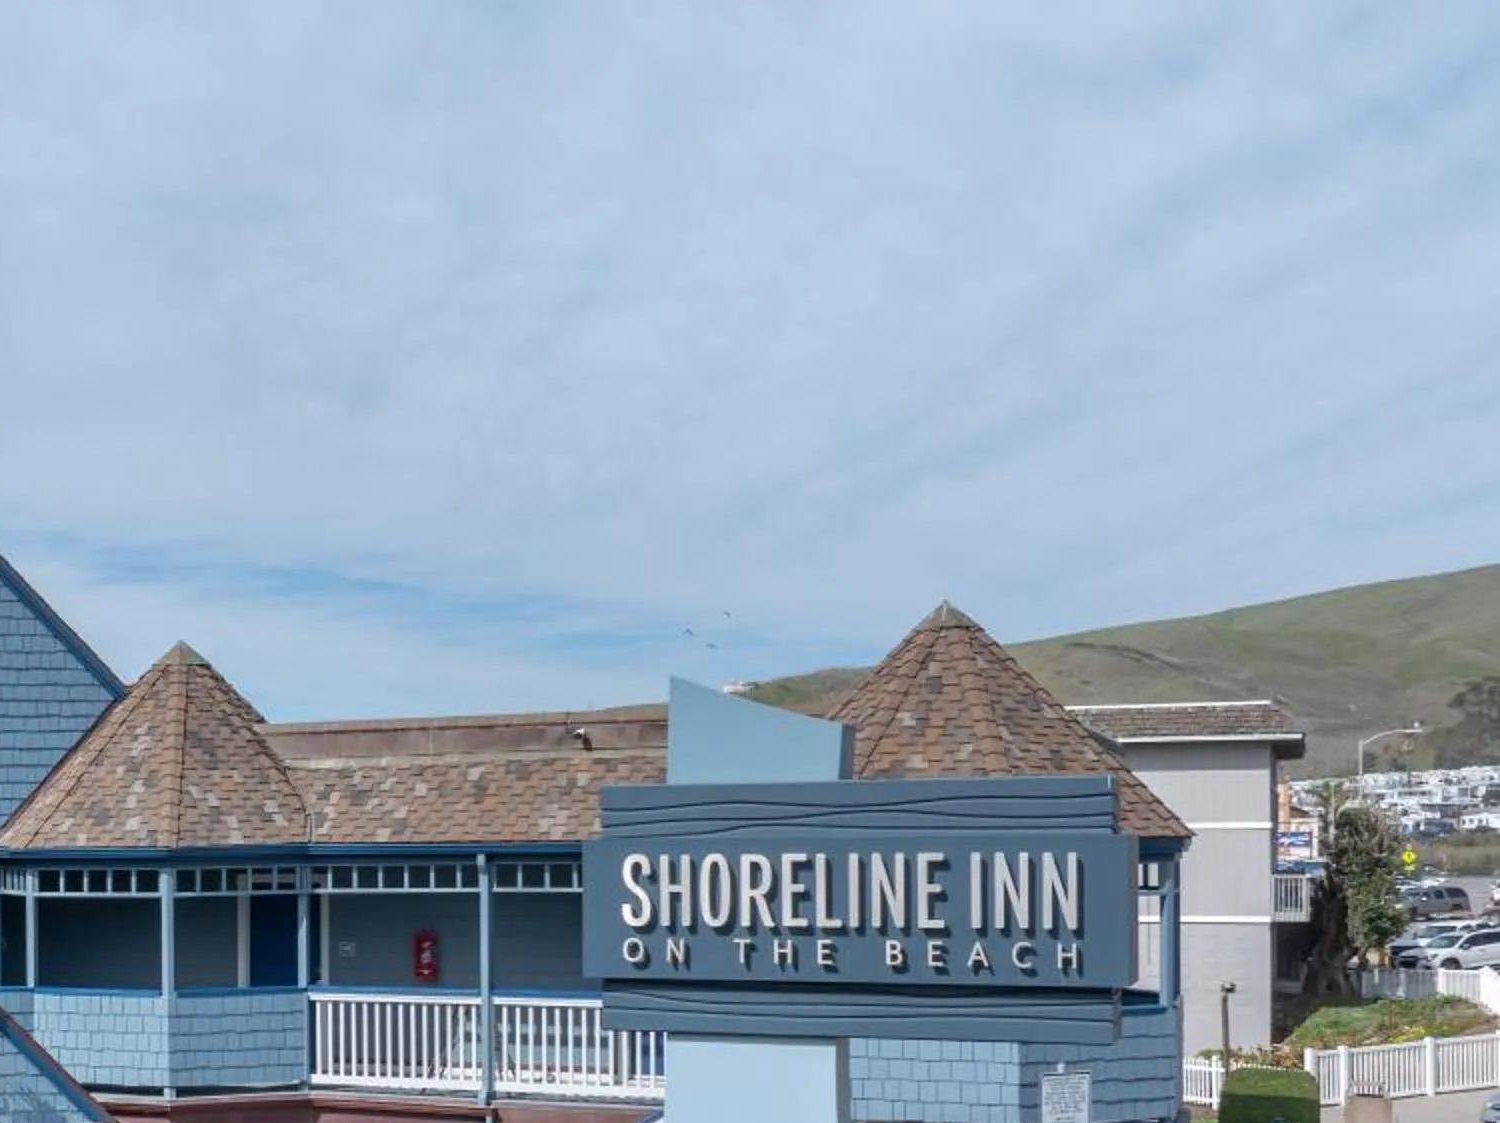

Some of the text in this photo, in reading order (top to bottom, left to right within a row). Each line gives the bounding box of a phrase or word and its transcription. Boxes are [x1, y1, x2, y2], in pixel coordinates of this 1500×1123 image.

[621, 851, 1078, 930] SHORELINE INN
[622, 937, 1078, 969] ON THE BEACH
